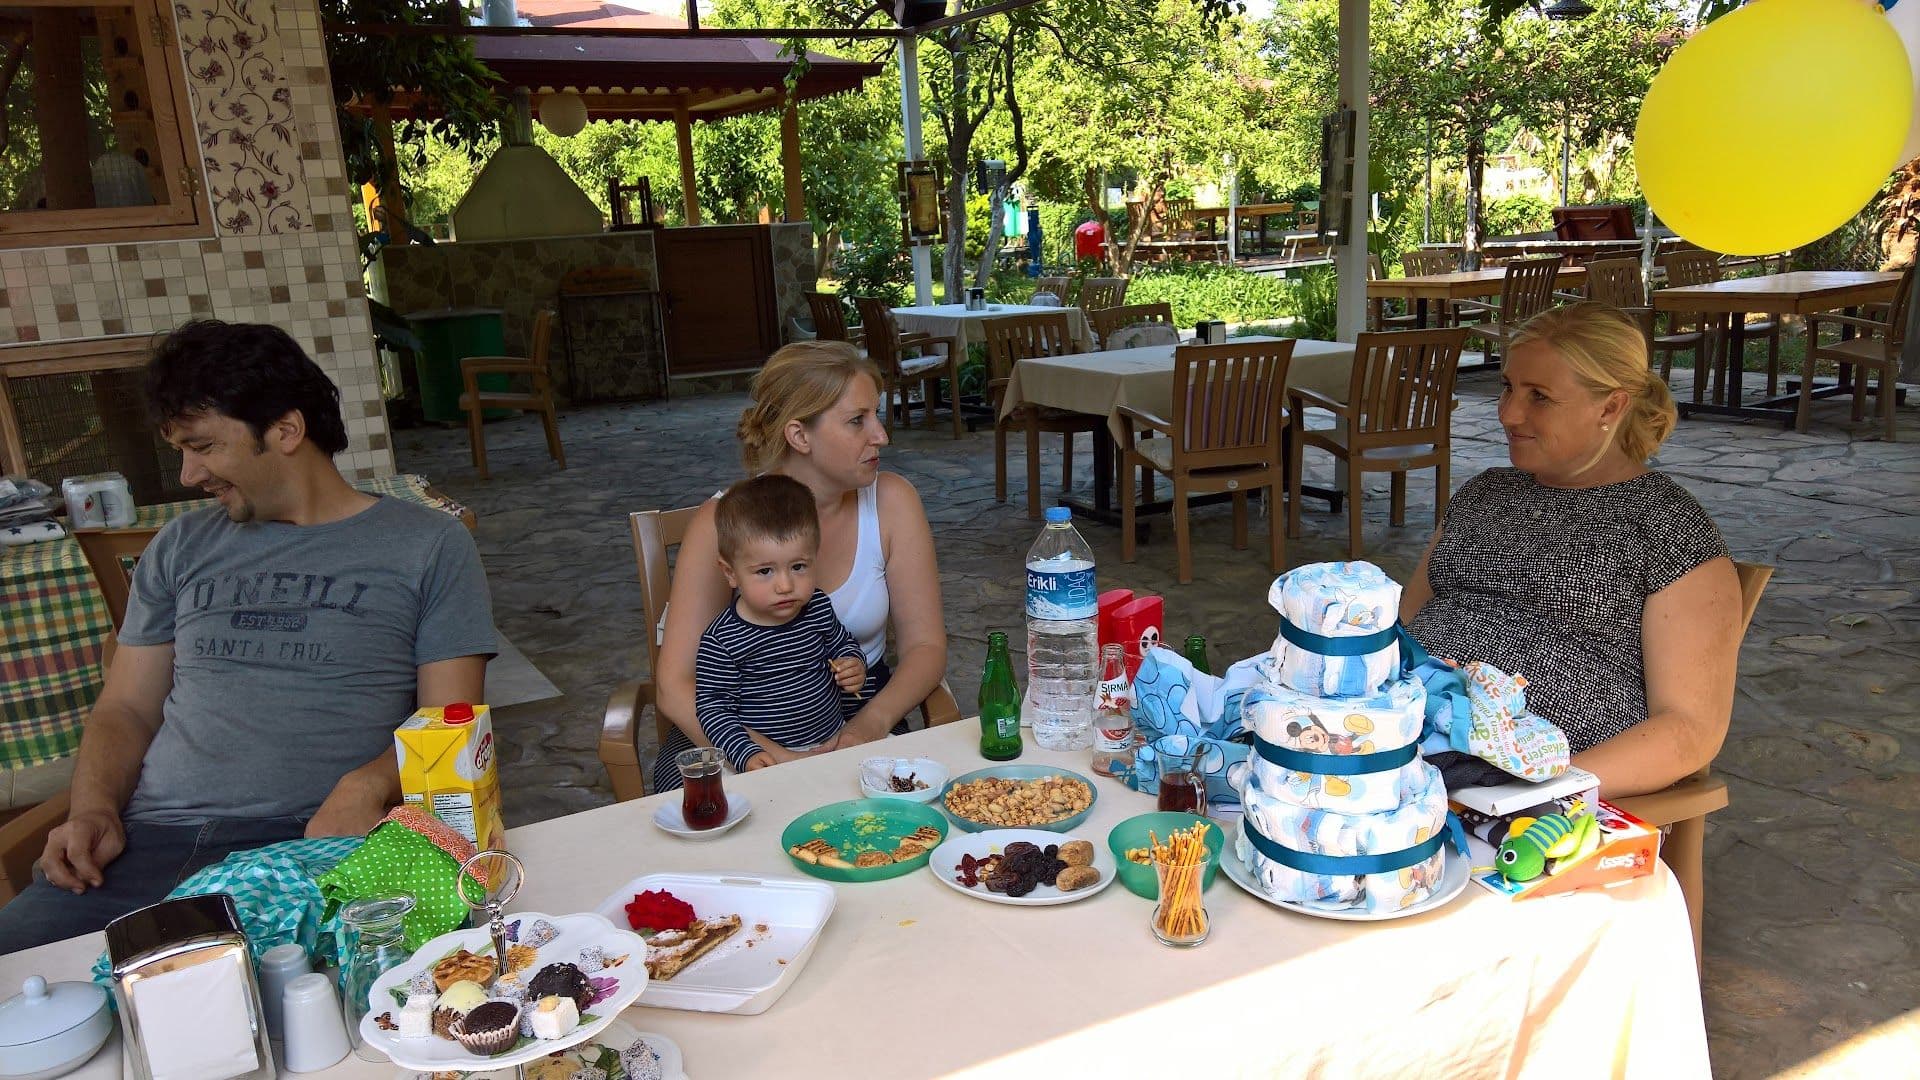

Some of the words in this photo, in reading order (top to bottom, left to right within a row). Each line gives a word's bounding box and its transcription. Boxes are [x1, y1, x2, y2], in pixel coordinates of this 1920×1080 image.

[1027, 572, 1057, 591] Erikli
[194, 637, 265, 657] SANTA
[1101, 682, 1129, 694] SIRMA
